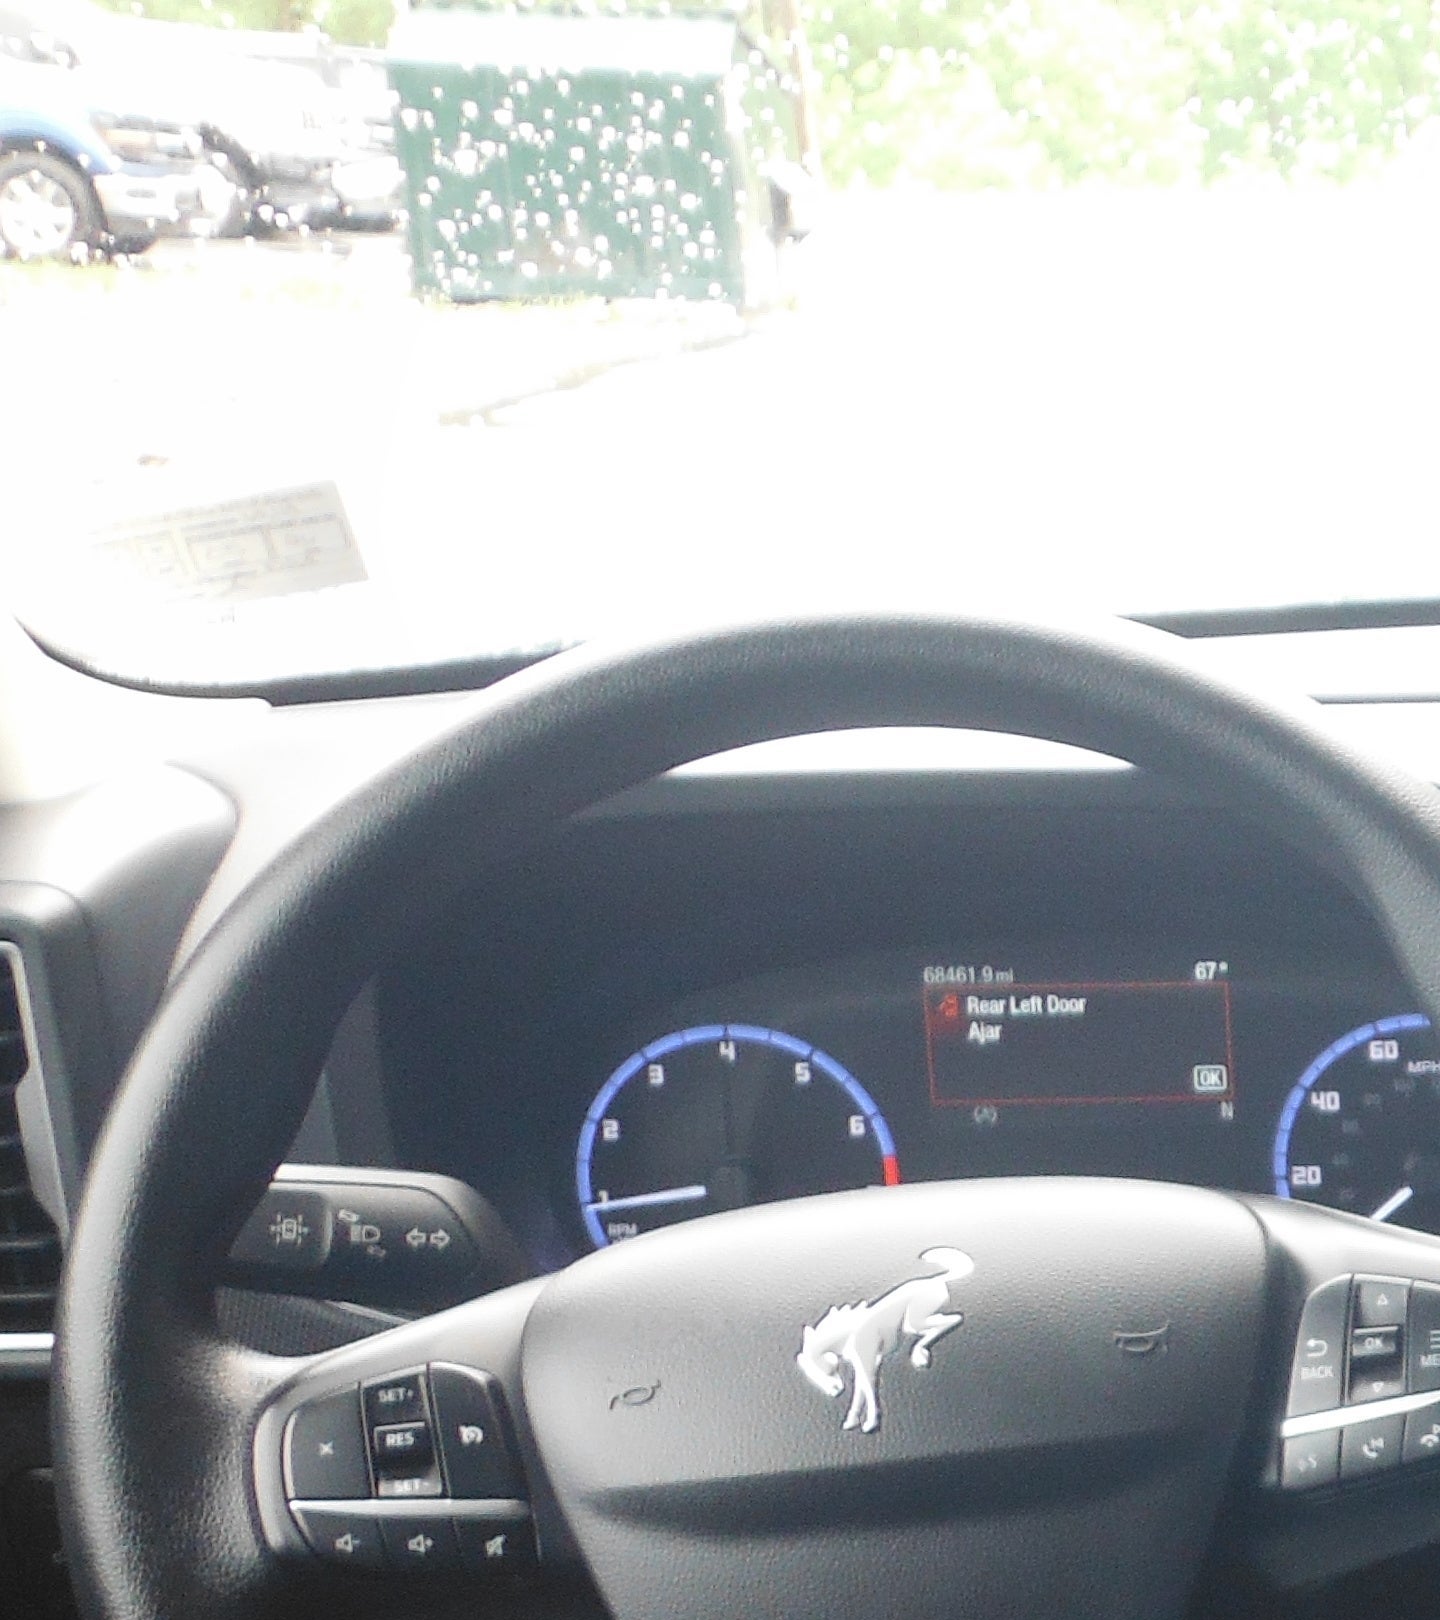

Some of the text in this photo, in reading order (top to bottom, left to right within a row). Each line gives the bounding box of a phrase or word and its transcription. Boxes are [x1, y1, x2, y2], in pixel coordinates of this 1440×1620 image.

[966, 994, 1087, 1015] Rear Left Door
[968, 1021, 1003, 1044] Ajar
[718, 1041, 736, 1061] 4
[1368, 1040, 1400, 1061] 60
[649, 1064, 664, 1085] 3
[795, 1062, 811, 1083] 5
[1200, 1070, 1221, 1087] OK
[1221, 1101, 1234, 1120] N
[1311, 1091, 1341, 1112] 40
[602, 1119, 619, 1140] 2
[848, 1115, 866, 1136] 6
[1291, 1166, 1322, 1185] 20
[1365, 1337, 1383, 1349] OK
[1301, 1365, 1334, 1380] BACK
[386, 1431, 414, 1447] RES
